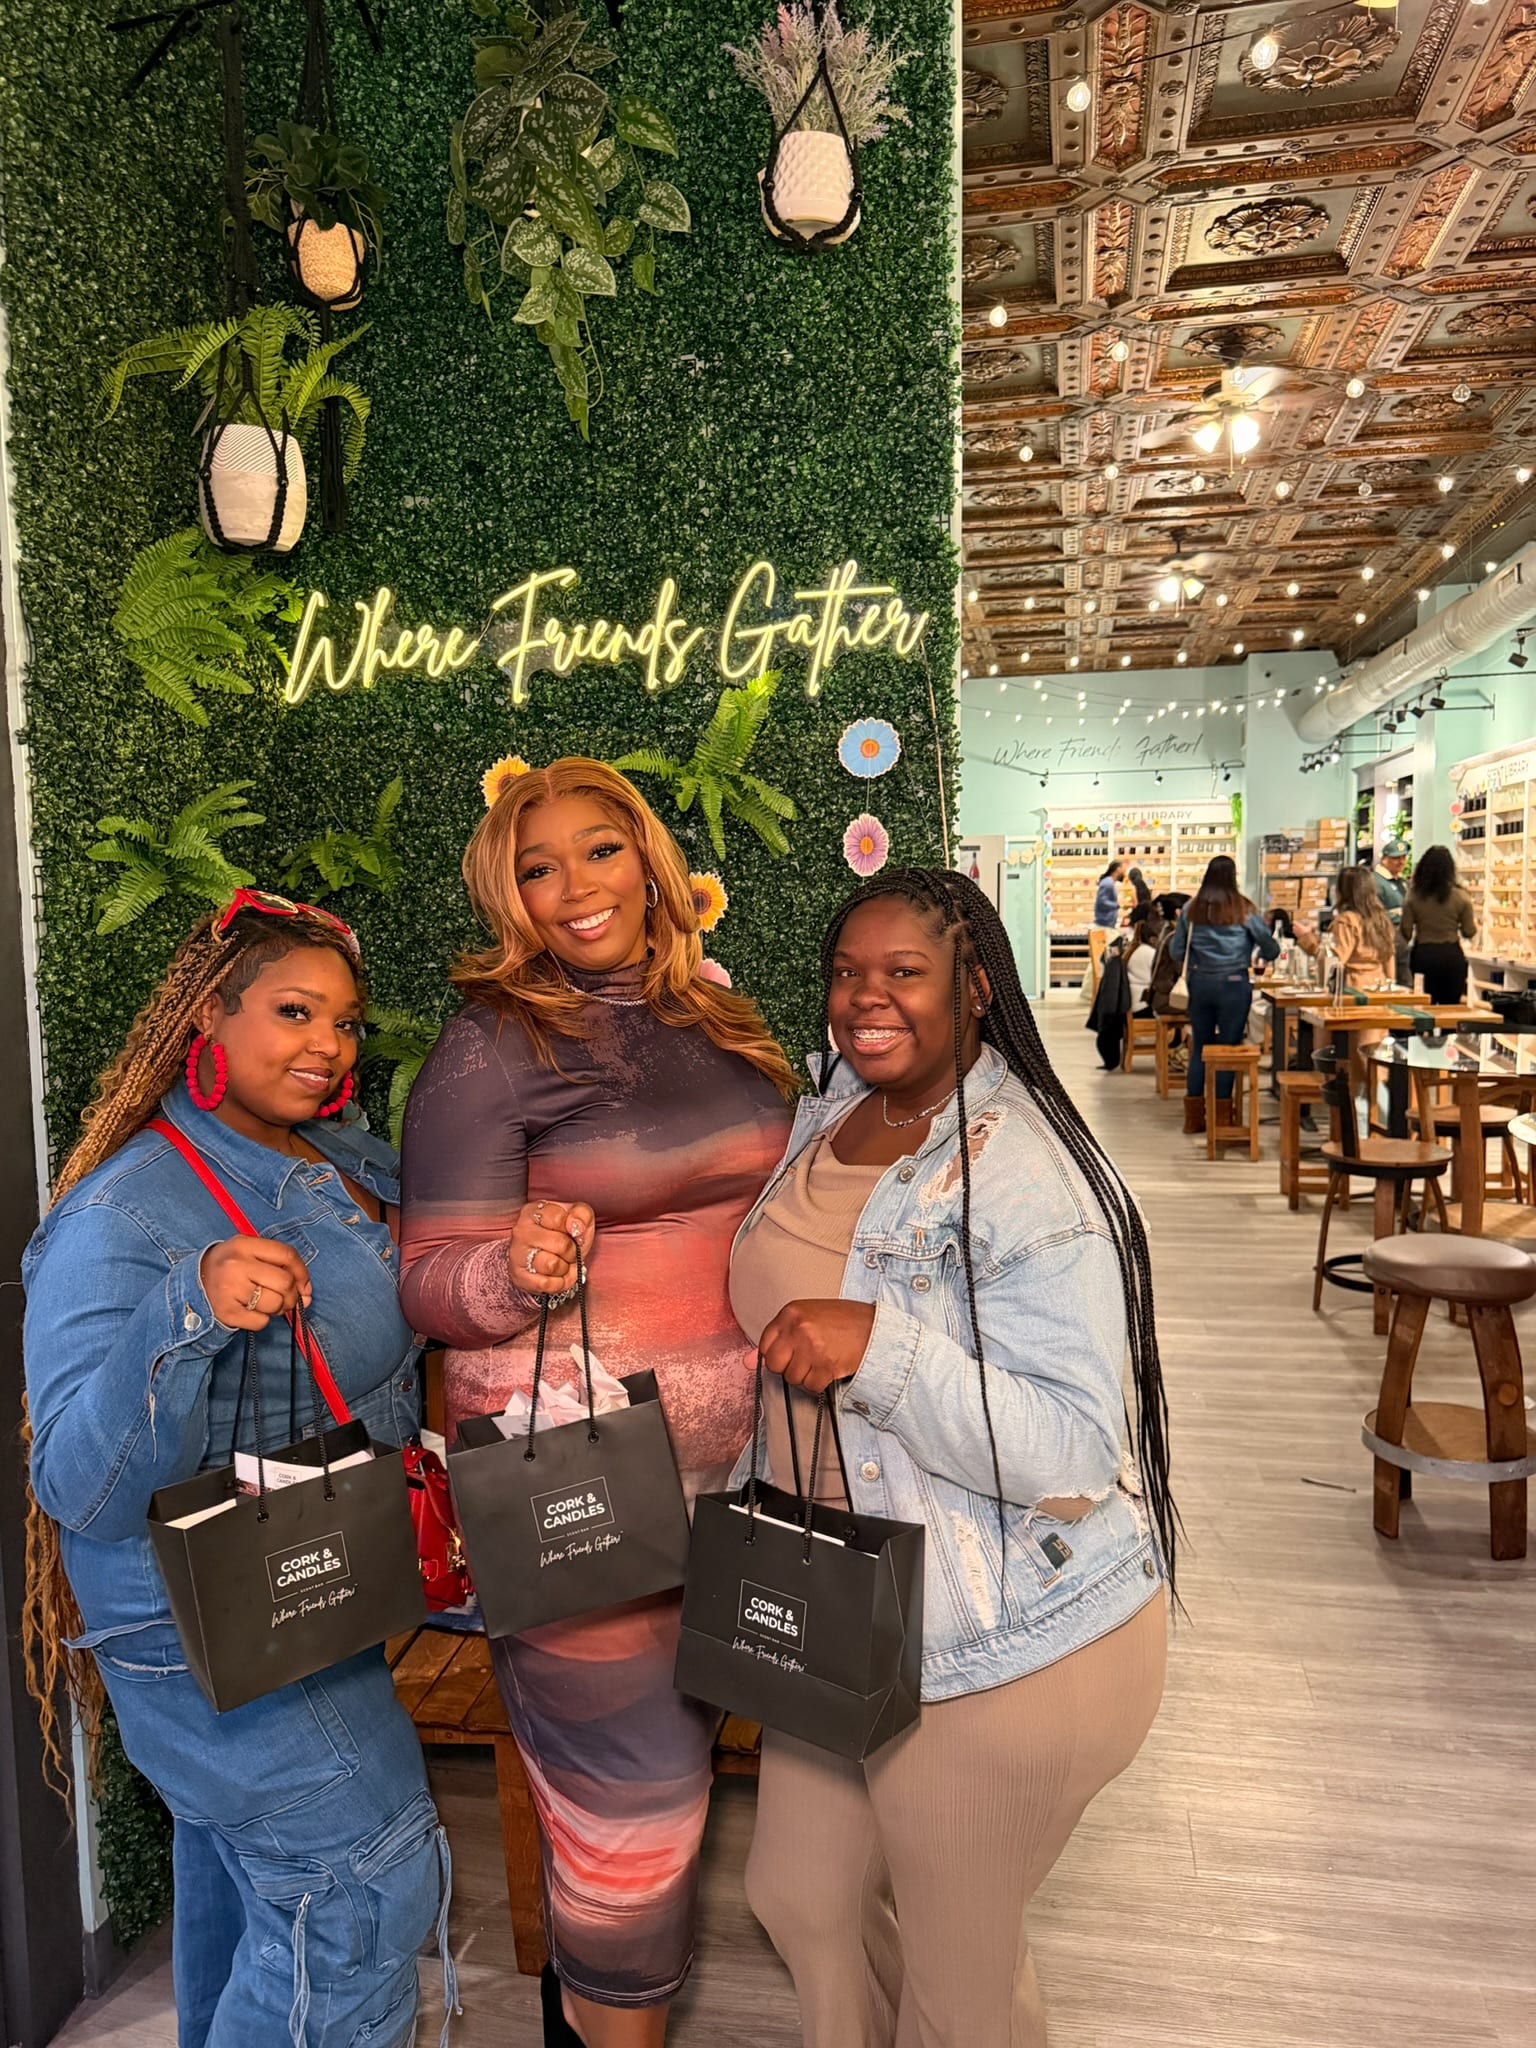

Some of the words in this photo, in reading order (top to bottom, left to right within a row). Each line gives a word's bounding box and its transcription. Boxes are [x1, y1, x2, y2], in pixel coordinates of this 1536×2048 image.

[284, 586, 480, 704] Where
[491, 567, 705, 704] Friends
[720, 559, 930, 697] Gather
[993, 738, 1051, 766] Where
[1141, 810, 1192, 820] LIBRARY
[543, 1503, 605, 1529] CANDLES
[546, 1496, 585, 1515] CORK
[586, 1492, 597, 1503] &
[280, 1551, 321, 1573] CORK
[322, 1547, 333, 1559] &
[540, 1549, 565, 1568] Where
[276, 1558, 341, 1587] CANDLES
[271, 1608, 297, 1628] Where
[744, 1608, 799, 1637] CANDLES
[750, 1597, 784, 1618] CORK
[785, 1609, 794, 1622] &
